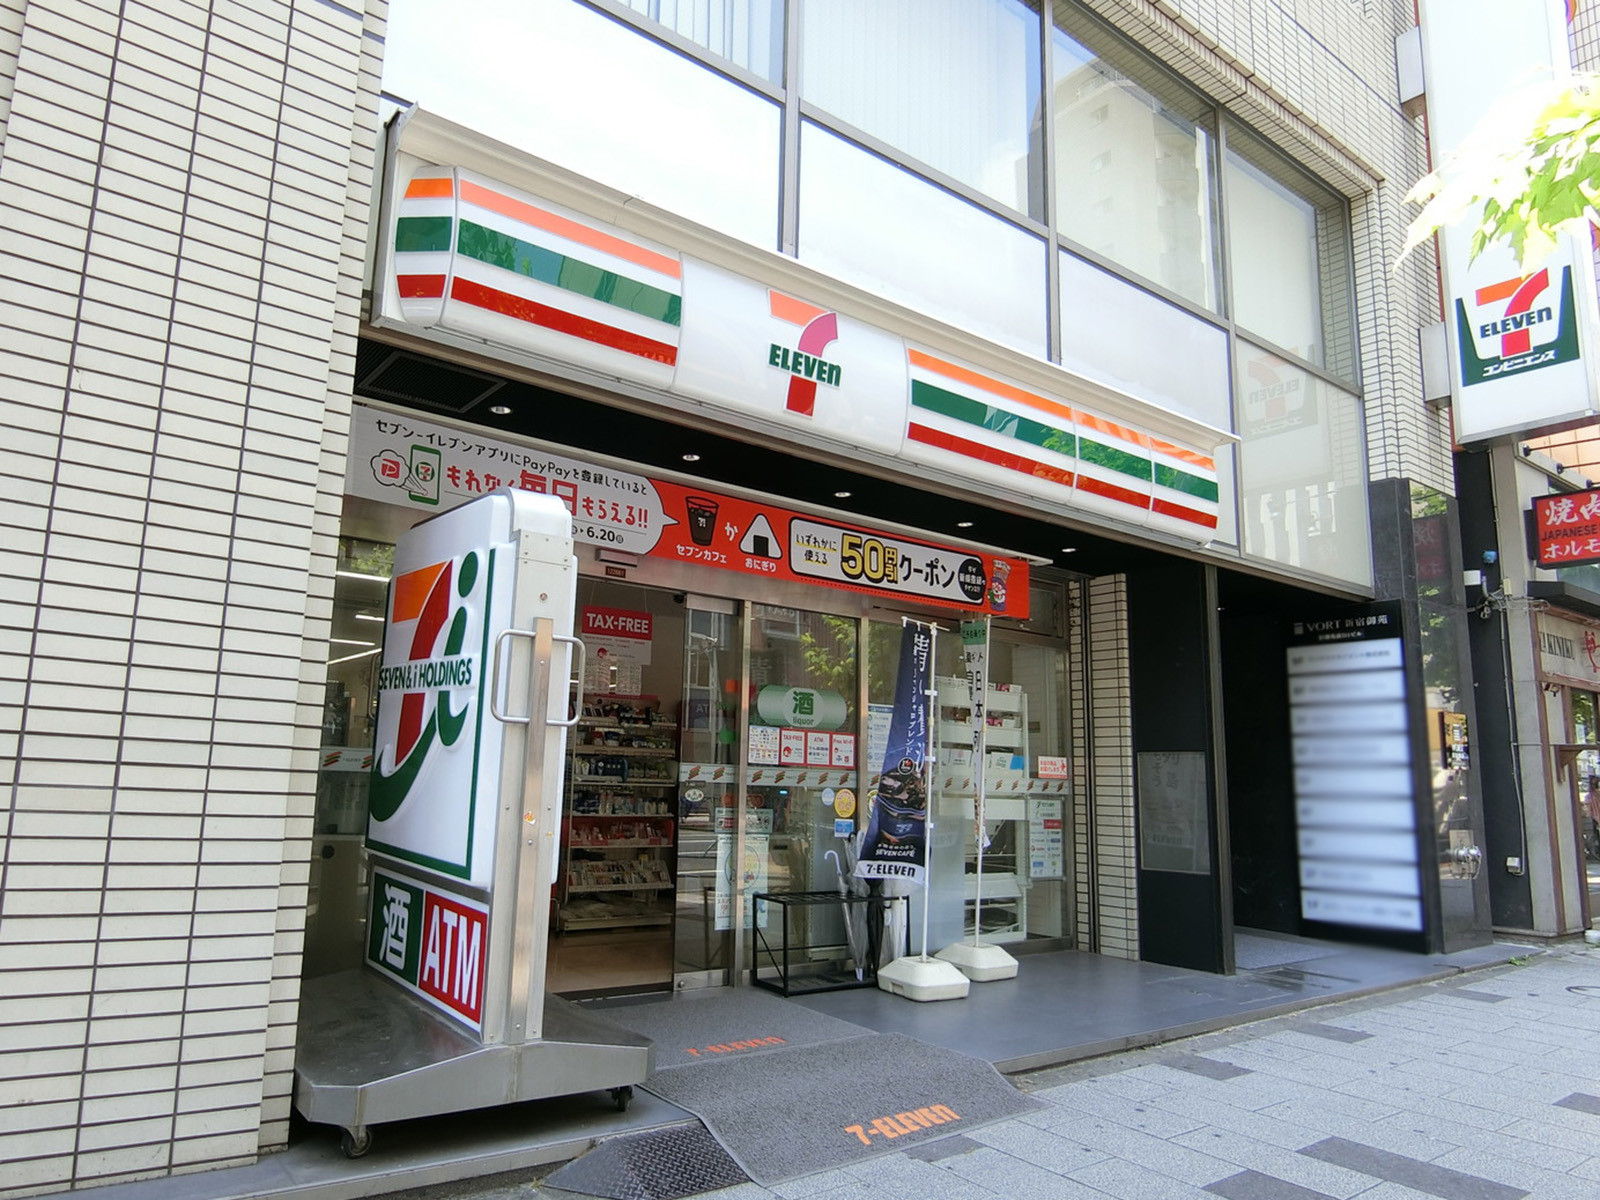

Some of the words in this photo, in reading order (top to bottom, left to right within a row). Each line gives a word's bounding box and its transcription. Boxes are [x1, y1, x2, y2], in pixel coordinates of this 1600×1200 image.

[1475, 267, 1549, 358] 7
[768, 289, 838, 417] 7
[724, 521, 739, 542] か
[1541, 524, 1598, 541] JAPANESE
[796, 532, 837, 553] いずれかに
[676, 543, 727, 565] セブンカフェ
[804, 551, 828, 566] 使える
[745, 557, 777, 574] おにぎり
[586, 612, 649, 634] TAX-FREE
[1306, 619, 1340, 631] VORT
[418, 658, 473, 689] HOLDINGS
[792, 690, 815, 716] 酒
[792, 716, 815, 726] liquor
[875, 848, 898, 857] SEVEN
[379, 882, 412, 971] 酒
[422, 904, 482, 1010] ATM
